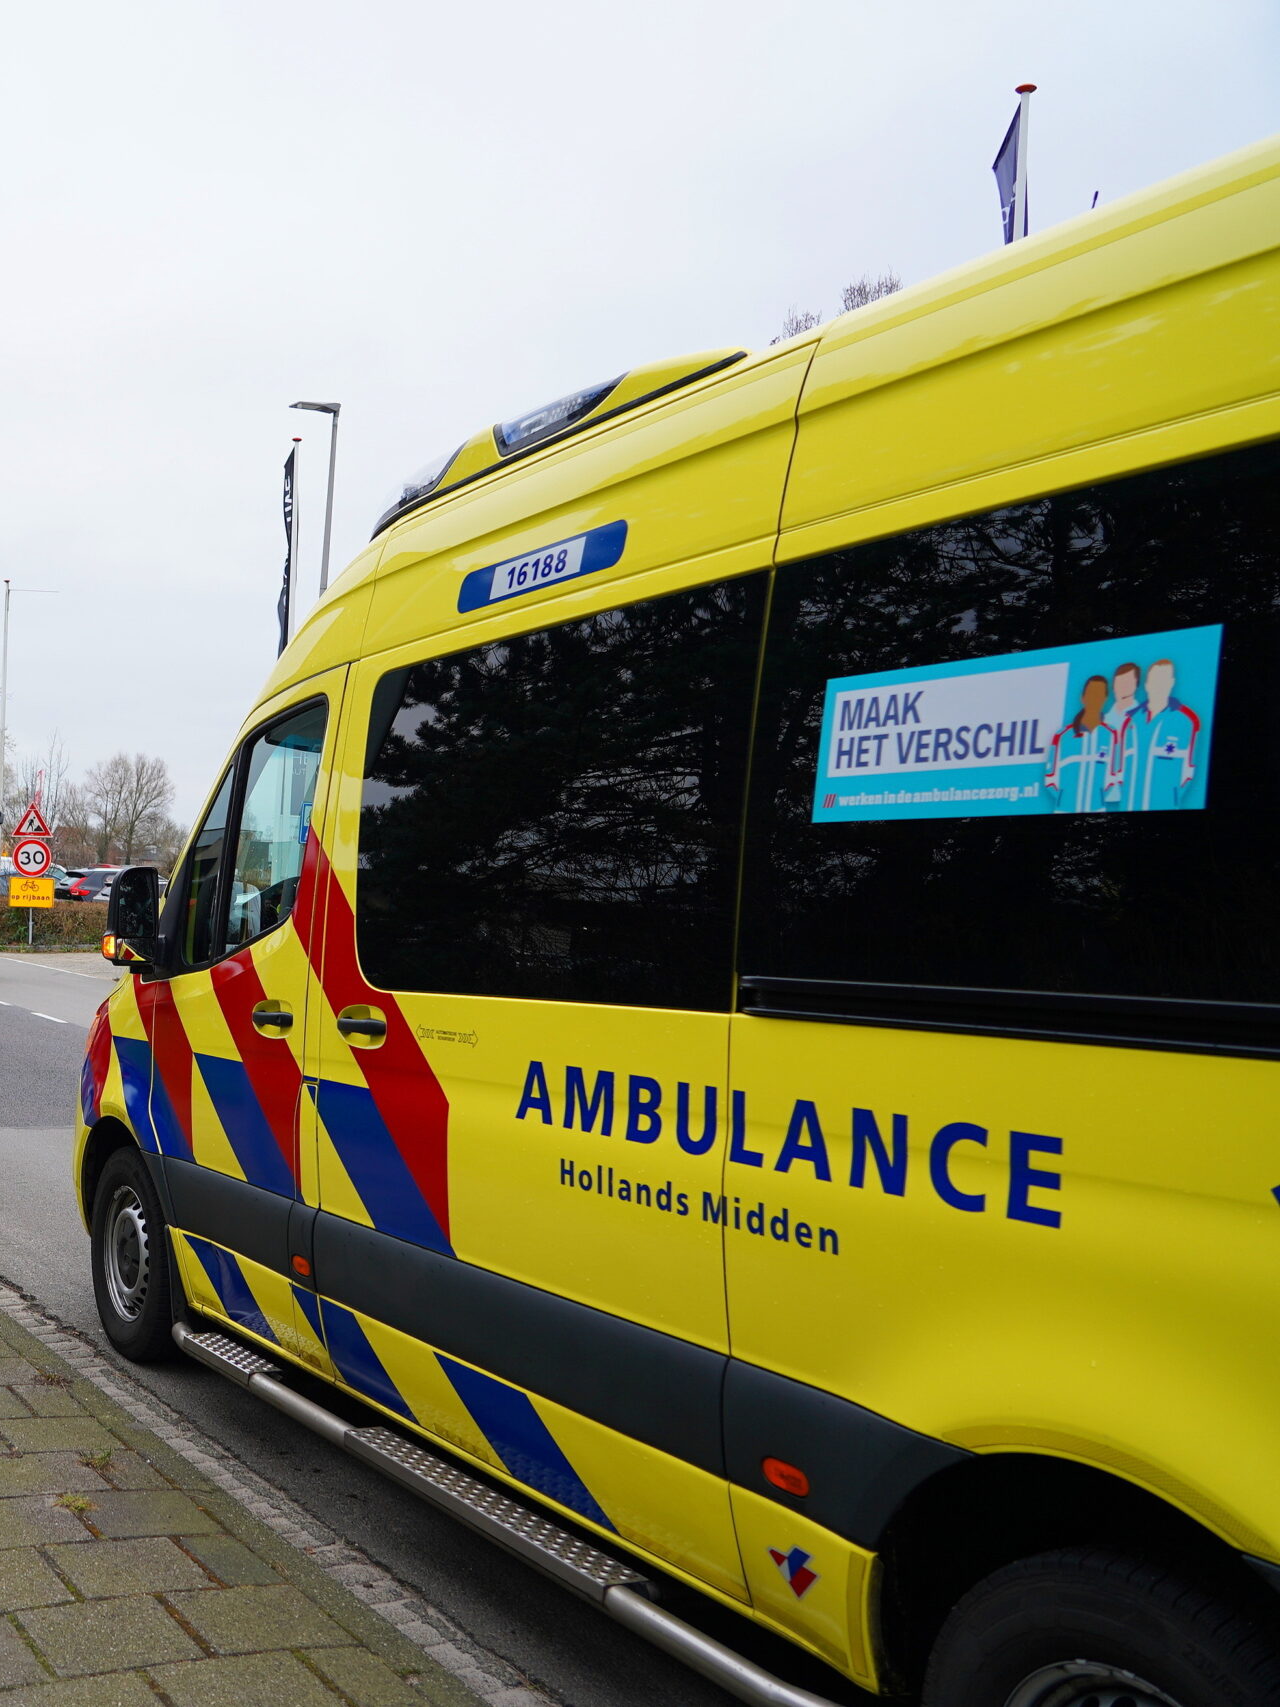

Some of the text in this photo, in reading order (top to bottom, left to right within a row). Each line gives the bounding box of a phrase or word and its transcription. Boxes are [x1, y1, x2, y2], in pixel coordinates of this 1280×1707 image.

[507, 548, 568, 589] 16188
[839, 690, 924, 732] MAAK
[835, 718, 1045, 770] HET VERSCHIL
[838, 782, 1040, 807] werkenindeambulancezorg.nl
[19, 851, 45, 866] 30
[22, 894, 50, 902] rijbaan
[515, 1060, 1064, 1229] AMBULANCE
[559, 1157, 840, 1256] Hollands Midden
